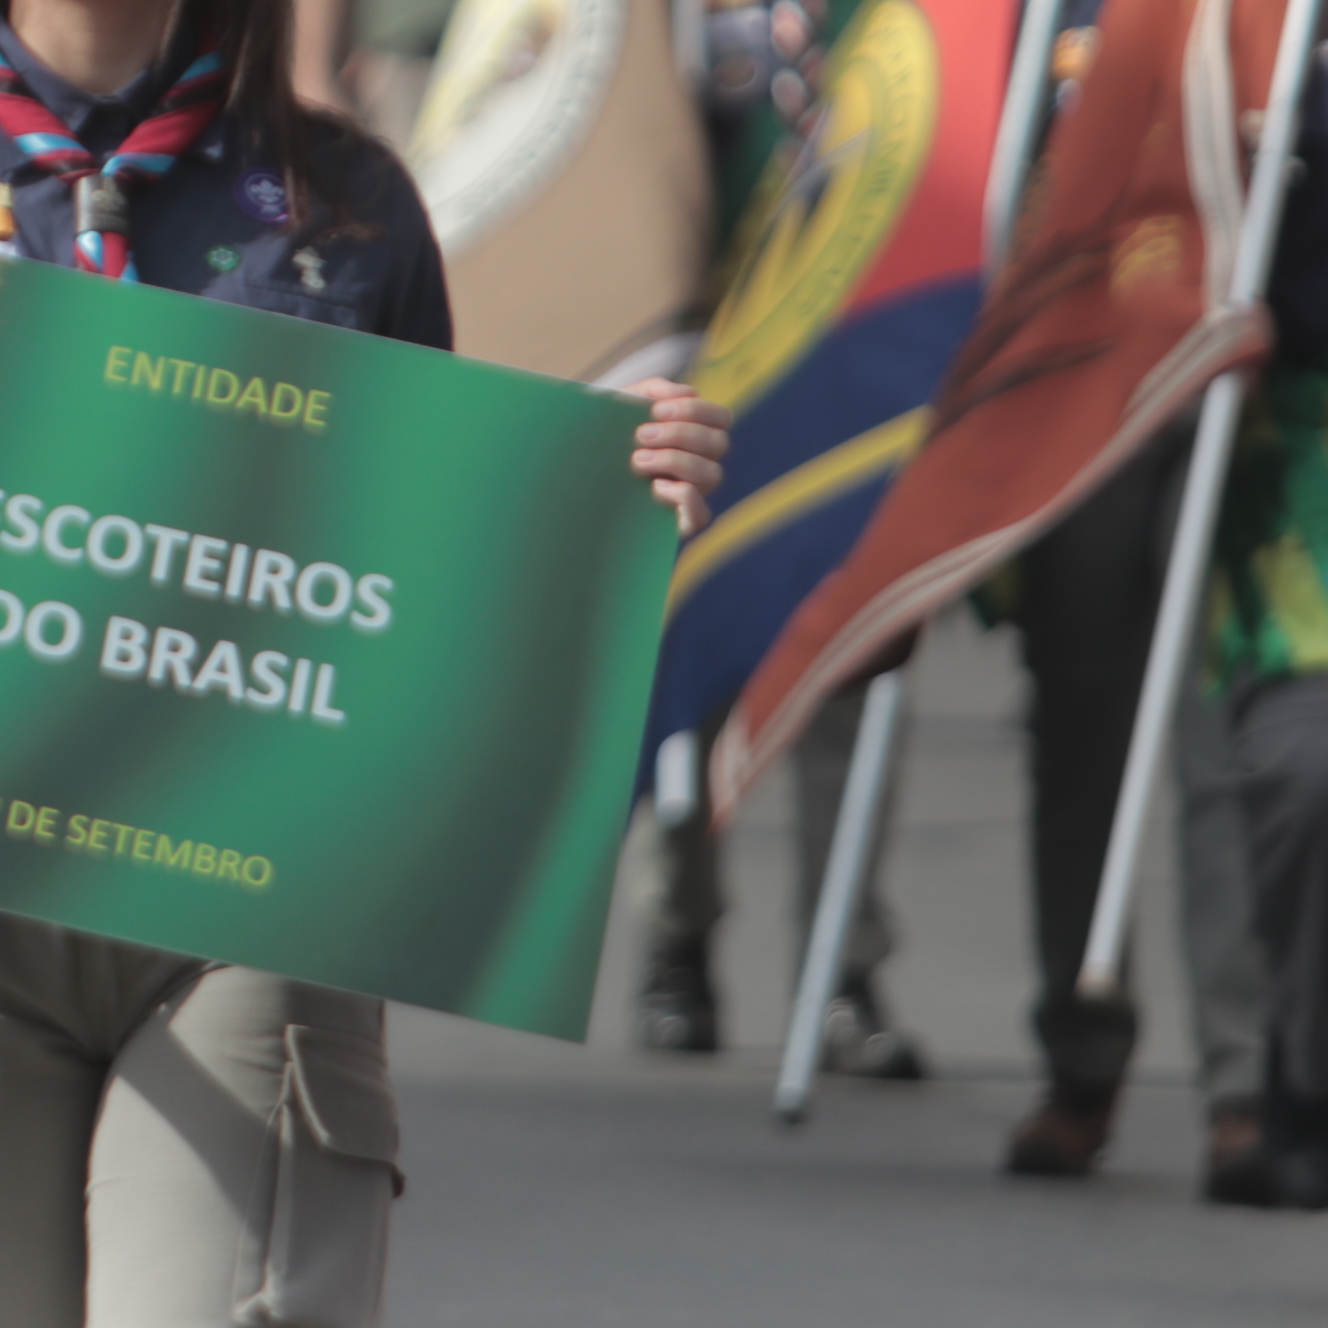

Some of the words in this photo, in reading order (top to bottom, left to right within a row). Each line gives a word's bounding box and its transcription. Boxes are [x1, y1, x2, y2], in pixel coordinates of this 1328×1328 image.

[105, 345, 333, 427] ENTIDADE
[101, 615, 345, 721] BRASIL
[7, 799, 60, 837] DE
[65, 814, 273, 885] SETEMBRO
